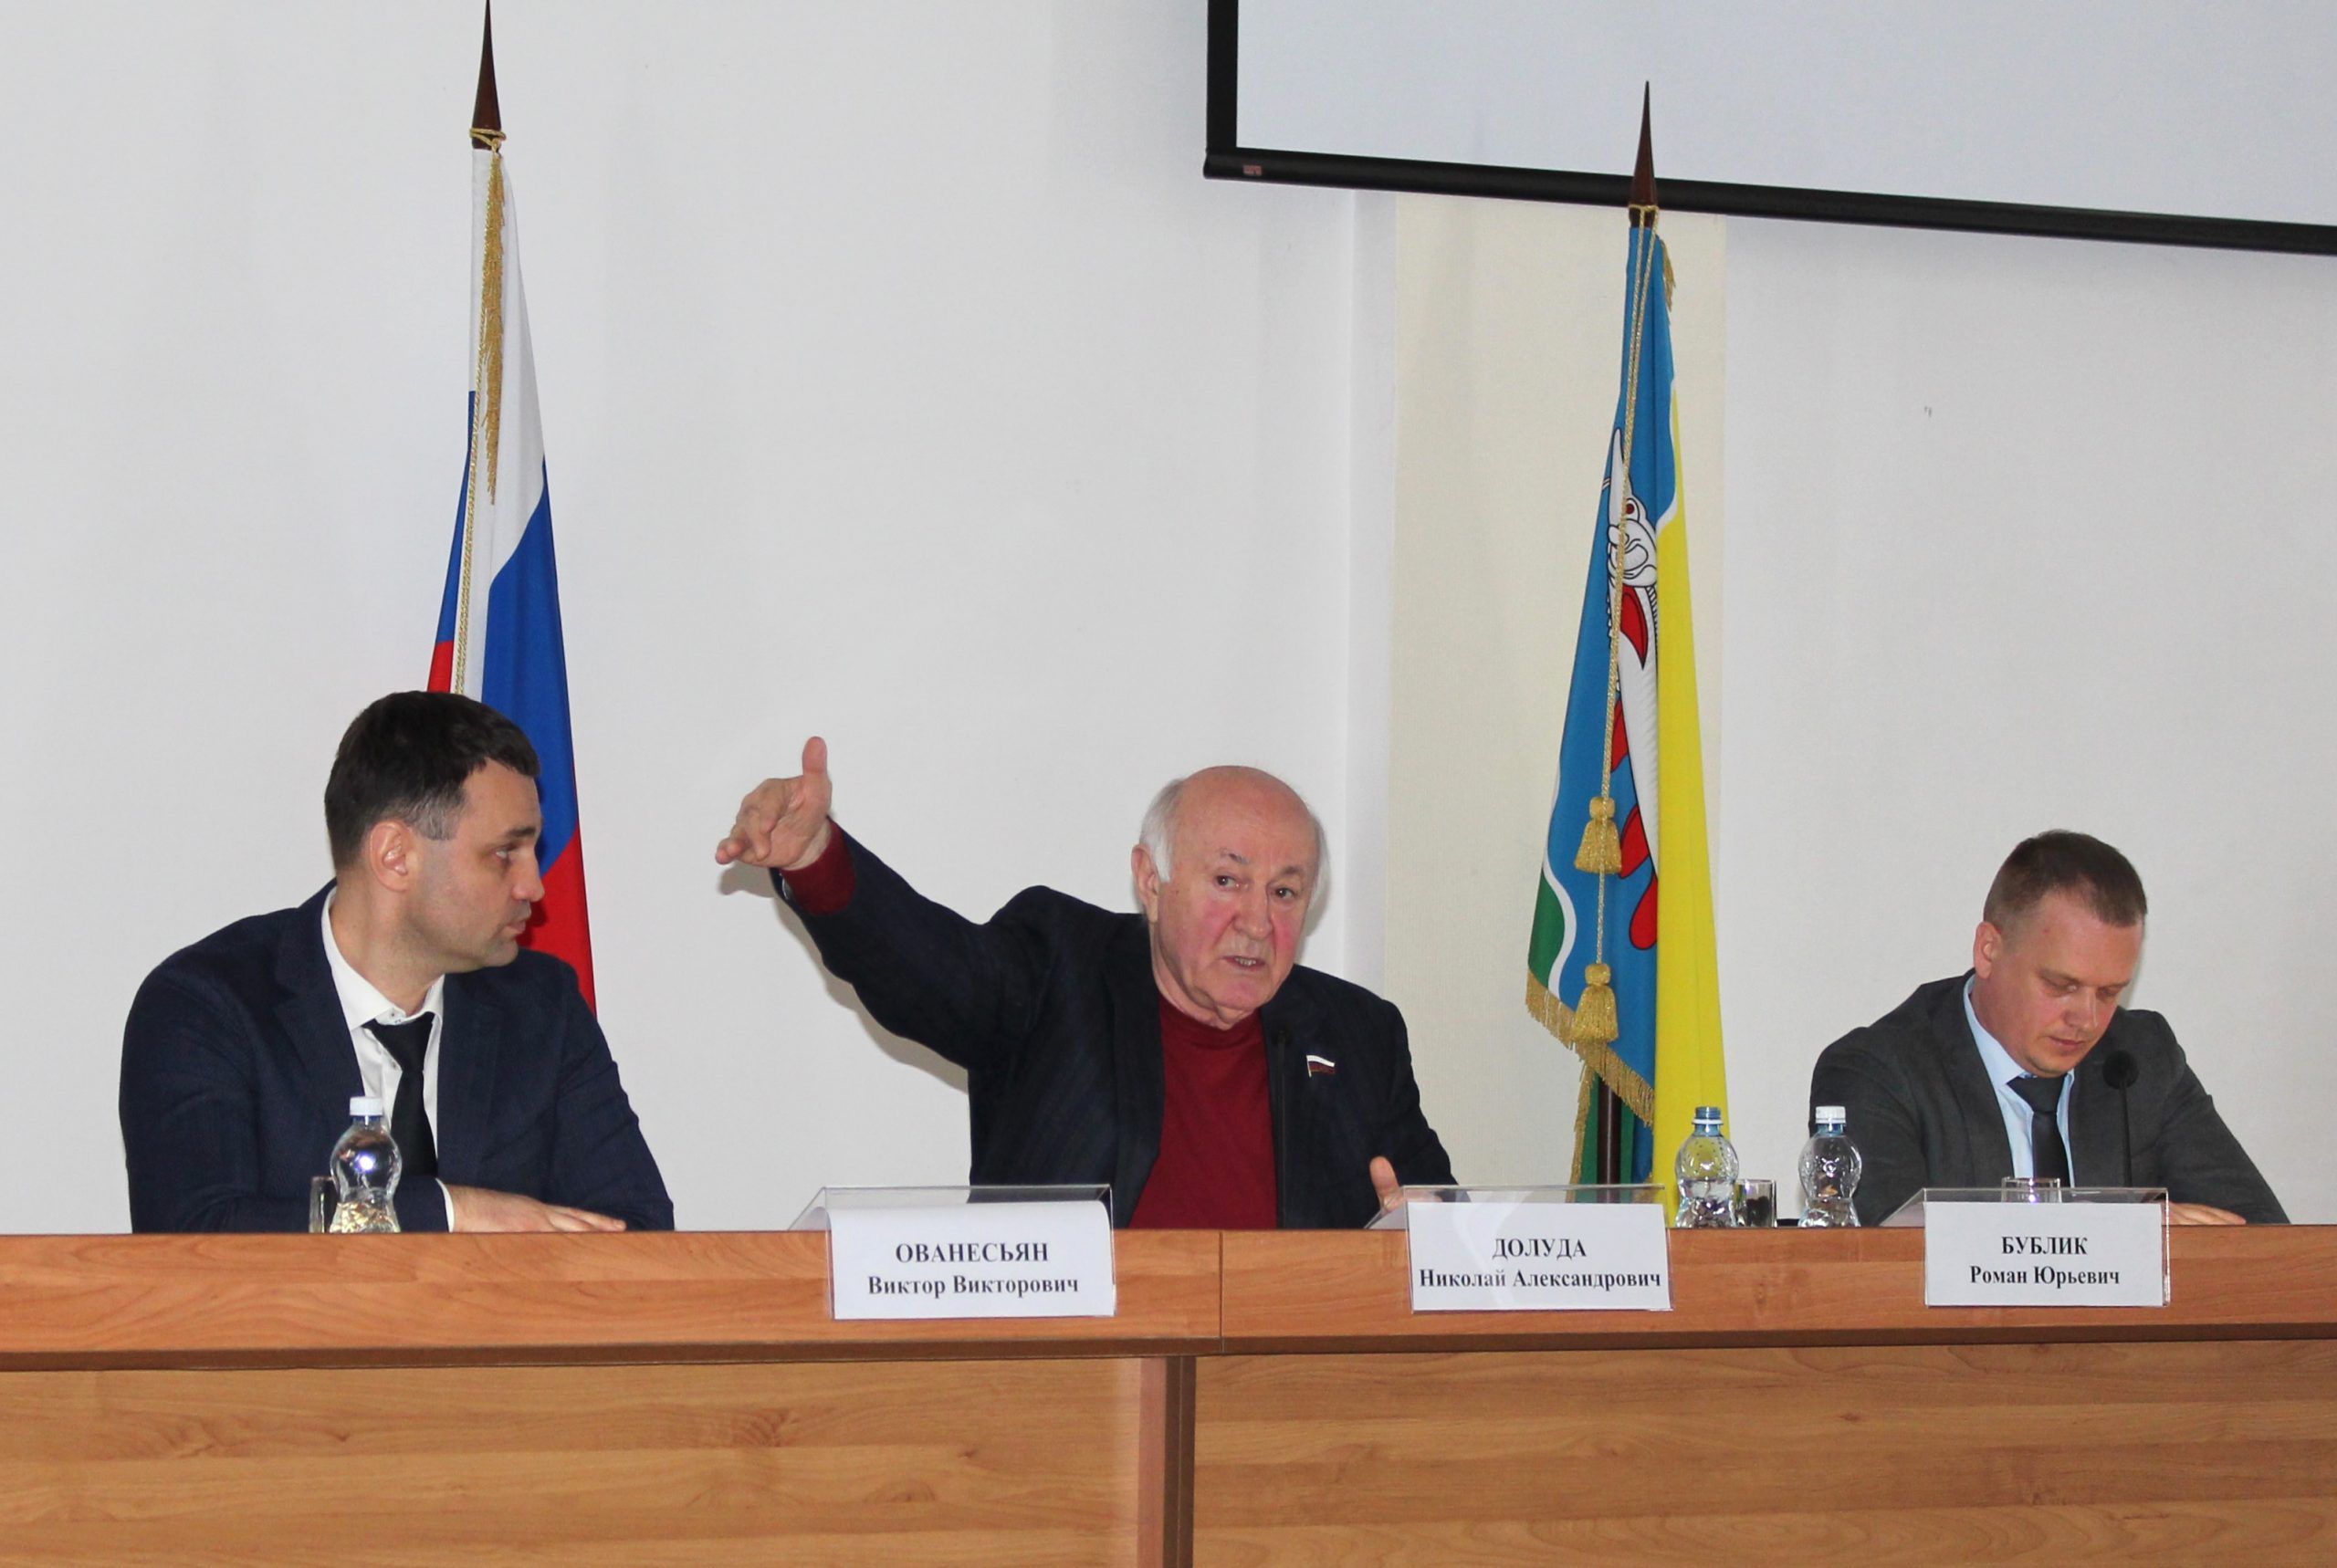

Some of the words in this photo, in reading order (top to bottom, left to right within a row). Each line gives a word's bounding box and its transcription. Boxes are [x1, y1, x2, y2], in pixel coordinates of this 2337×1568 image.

[895, 1242, 1048, 1263] ОВАНЕСЬЯН
[1492, 1238, 1588, 1260] ДОЛУДА
[2001, 1236, 2088, 1255] БУБЛИК
[868, 1276, 946, 1300] Виктор
[953, 1274, 1078, 1299] Викторович
[1419, 1269, 1506, 1288] Николай
[1513, 1270, 1661, 1292] Александрович
[1970, 1265, 2028, 1284] Роман
[2033, 1265, 2120, 1290] Юрьевич
